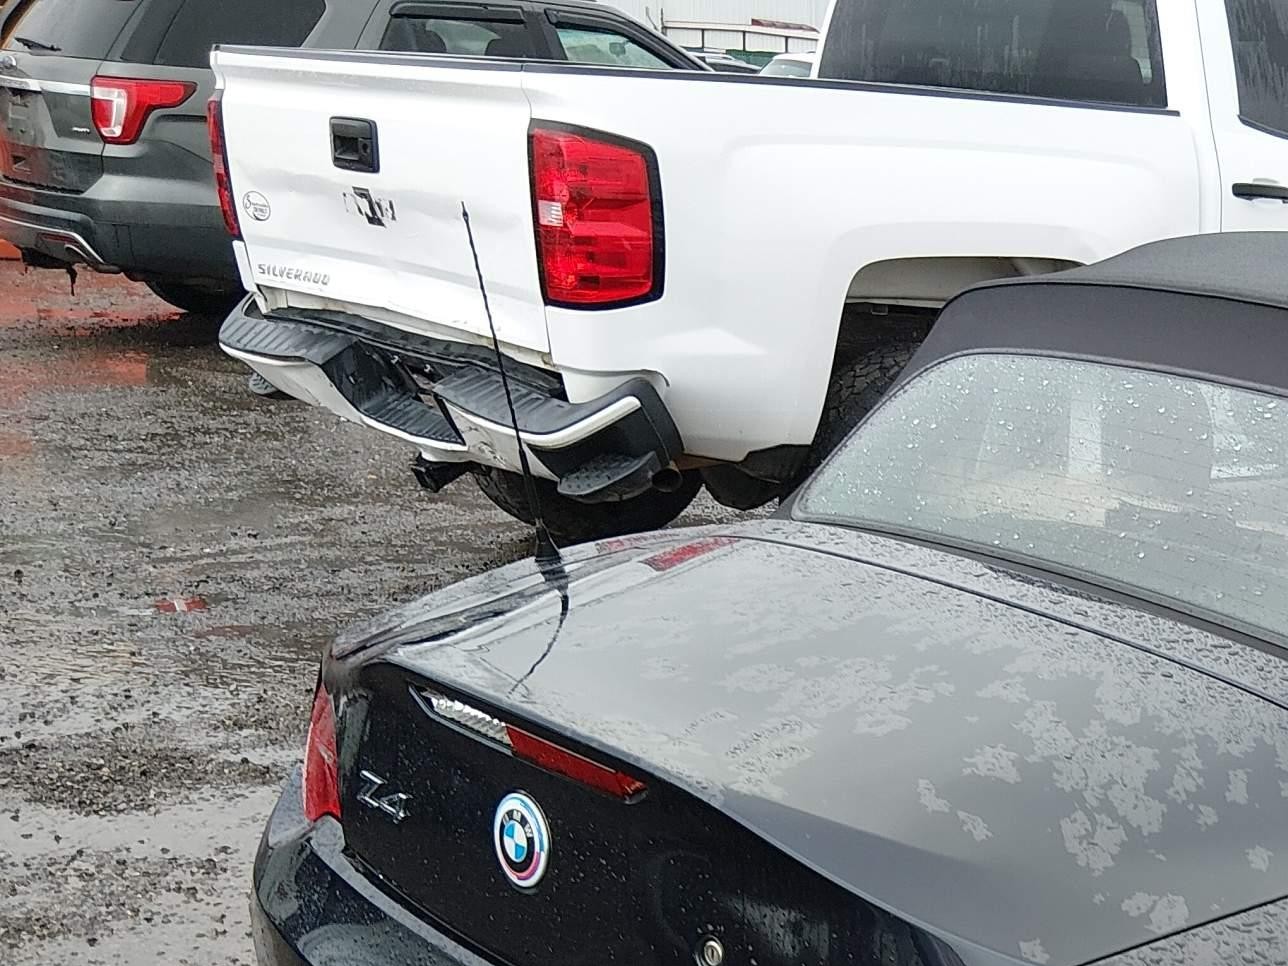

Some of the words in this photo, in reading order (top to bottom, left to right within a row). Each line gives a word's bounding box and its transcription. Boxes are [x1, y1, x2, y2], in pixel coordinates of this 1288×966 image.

[257, 263, 330, 286] SILVERADO
[357, 769, 413, 824] Z4
[502, 808, 534, 838] BMW
